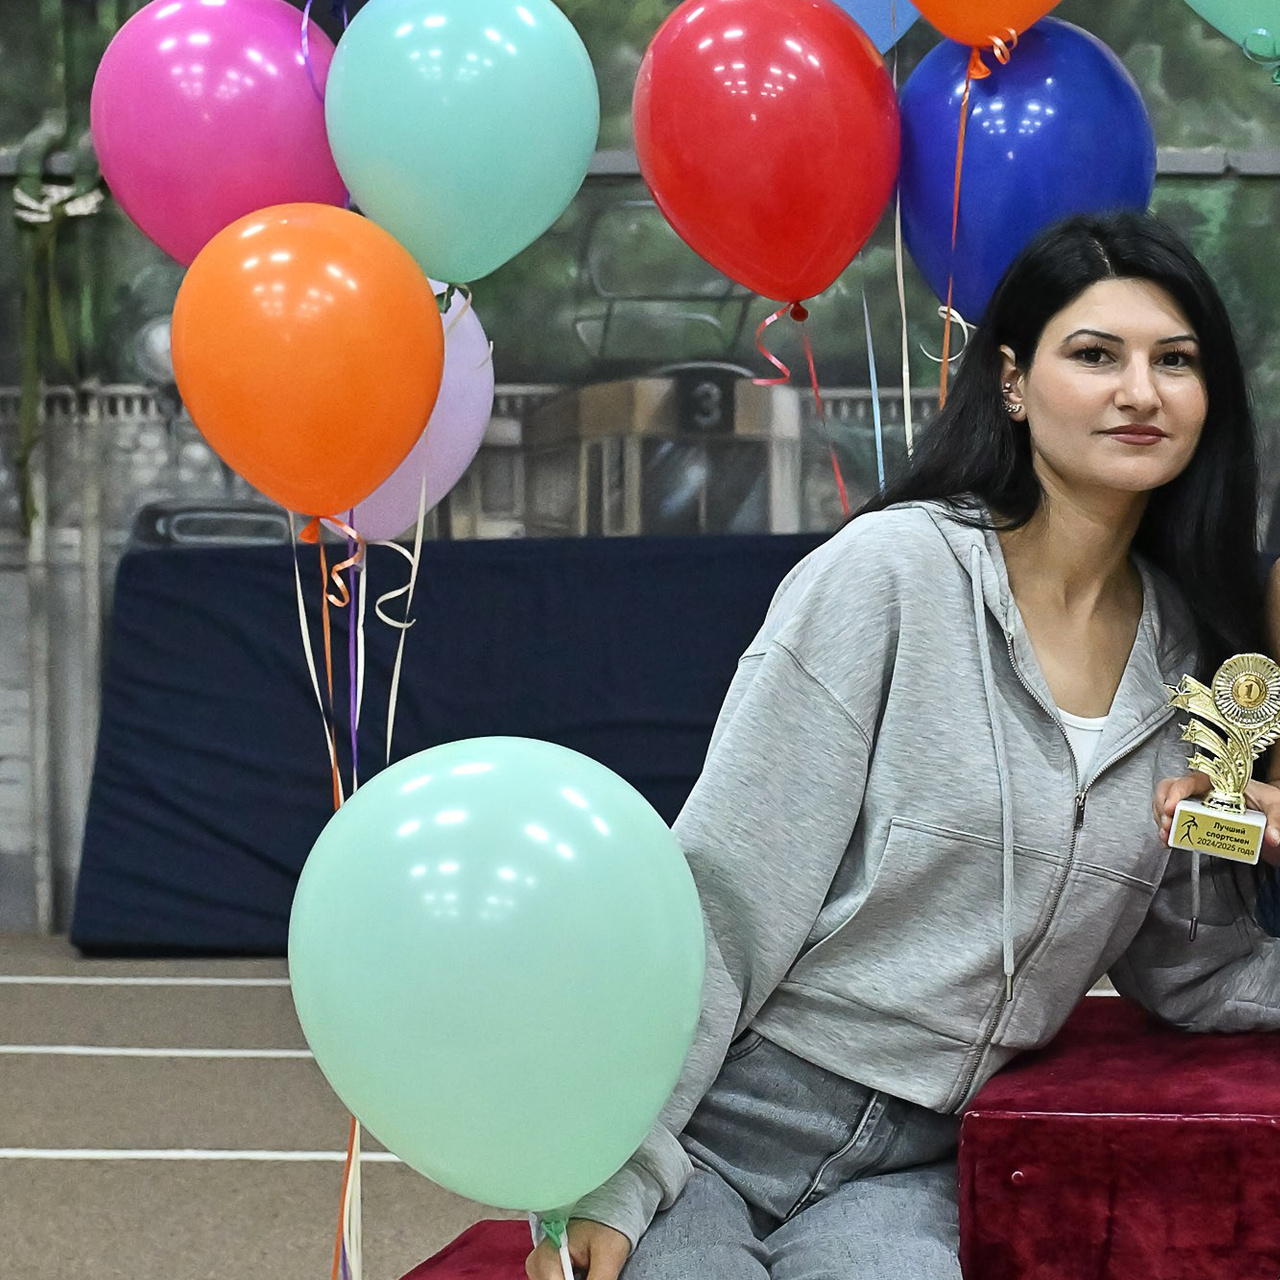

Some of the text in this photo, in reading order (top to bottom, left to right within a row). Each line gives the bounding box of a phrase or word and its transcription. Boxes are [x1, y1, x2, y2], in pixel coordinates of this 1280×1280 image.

[1244, 683, 1254, 700] 1
[1213, 821, 1246, 835] Лучший
[1206, 830, 1250, 845] спортсмен
[1197, 837, 1255, 856] 2024/2025 года
